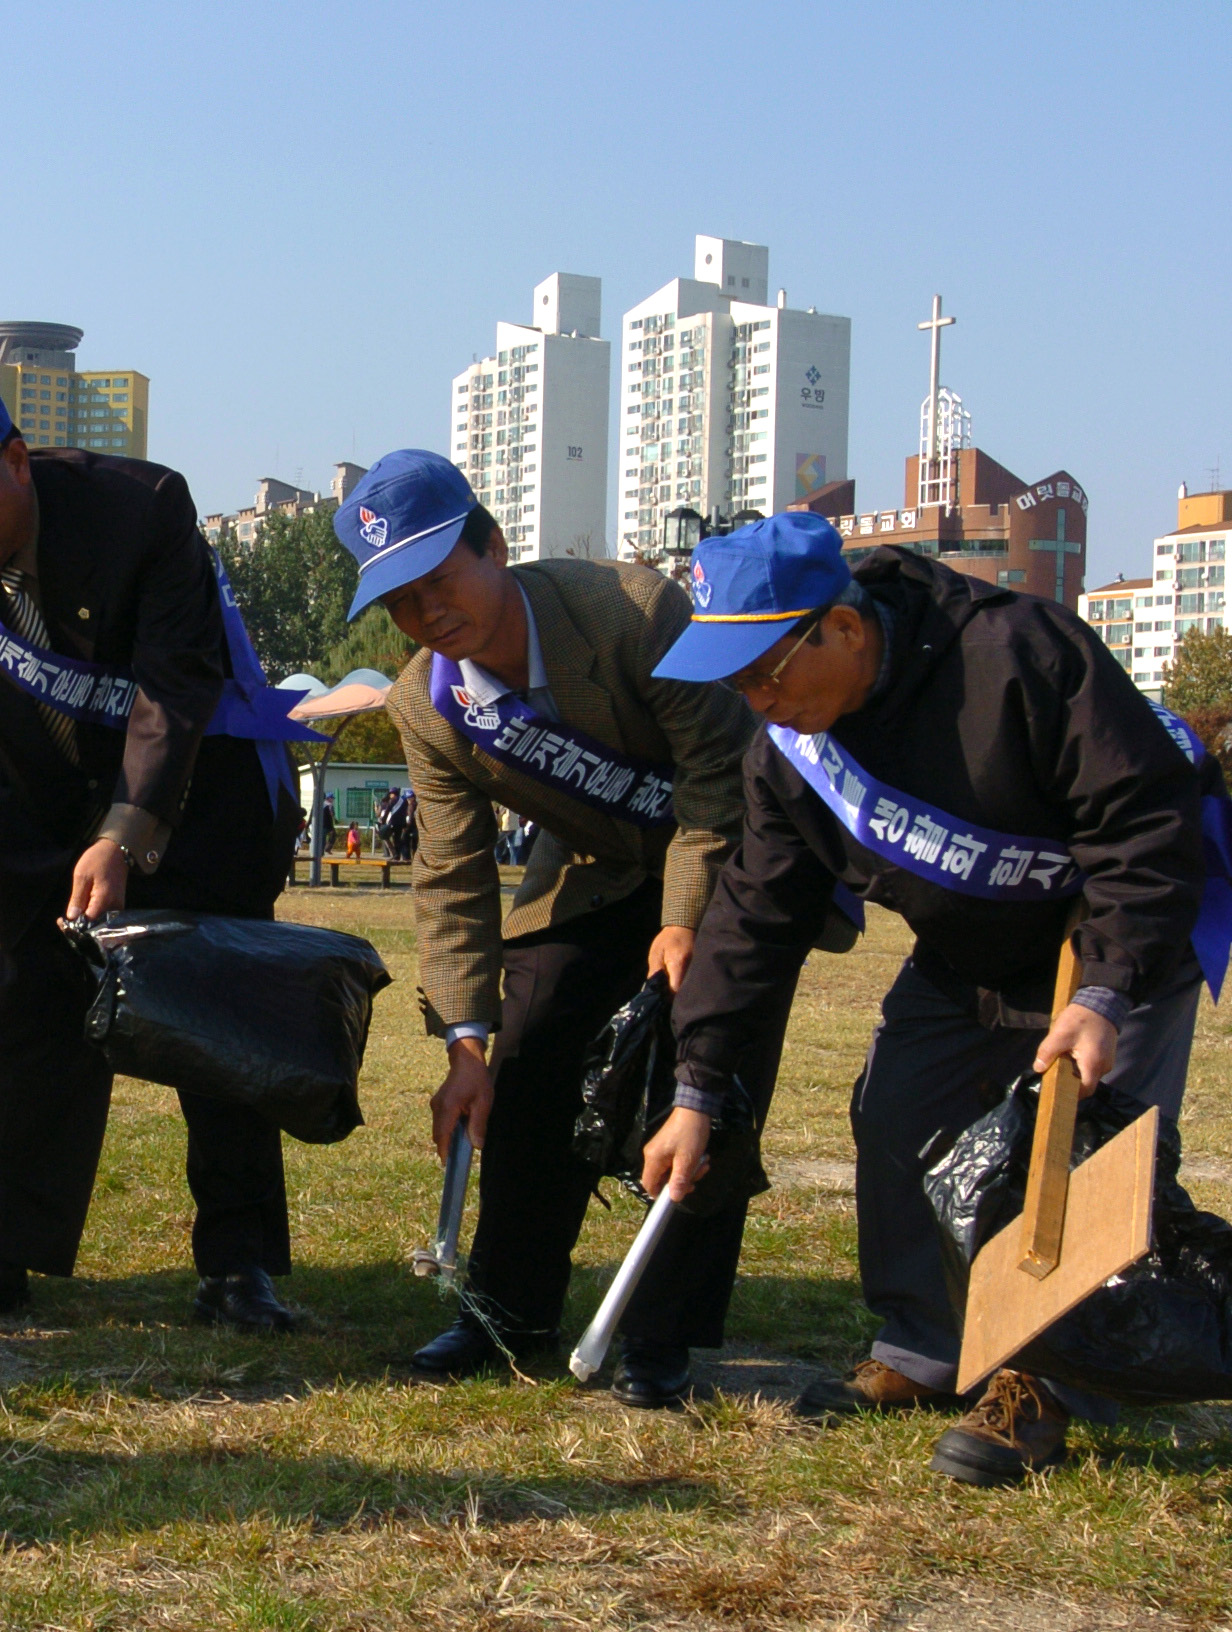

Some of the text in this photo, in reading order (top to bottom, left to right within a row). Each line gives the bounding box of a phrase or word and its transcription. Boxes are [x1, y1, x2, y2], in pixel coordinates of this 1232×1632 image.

[567, 446, 583, 458] 102
[828, 511, 916, 537] 릿돌교회
[869, 797, 988, 880] 생활화
[988, 845, 1075, 890] 합시
